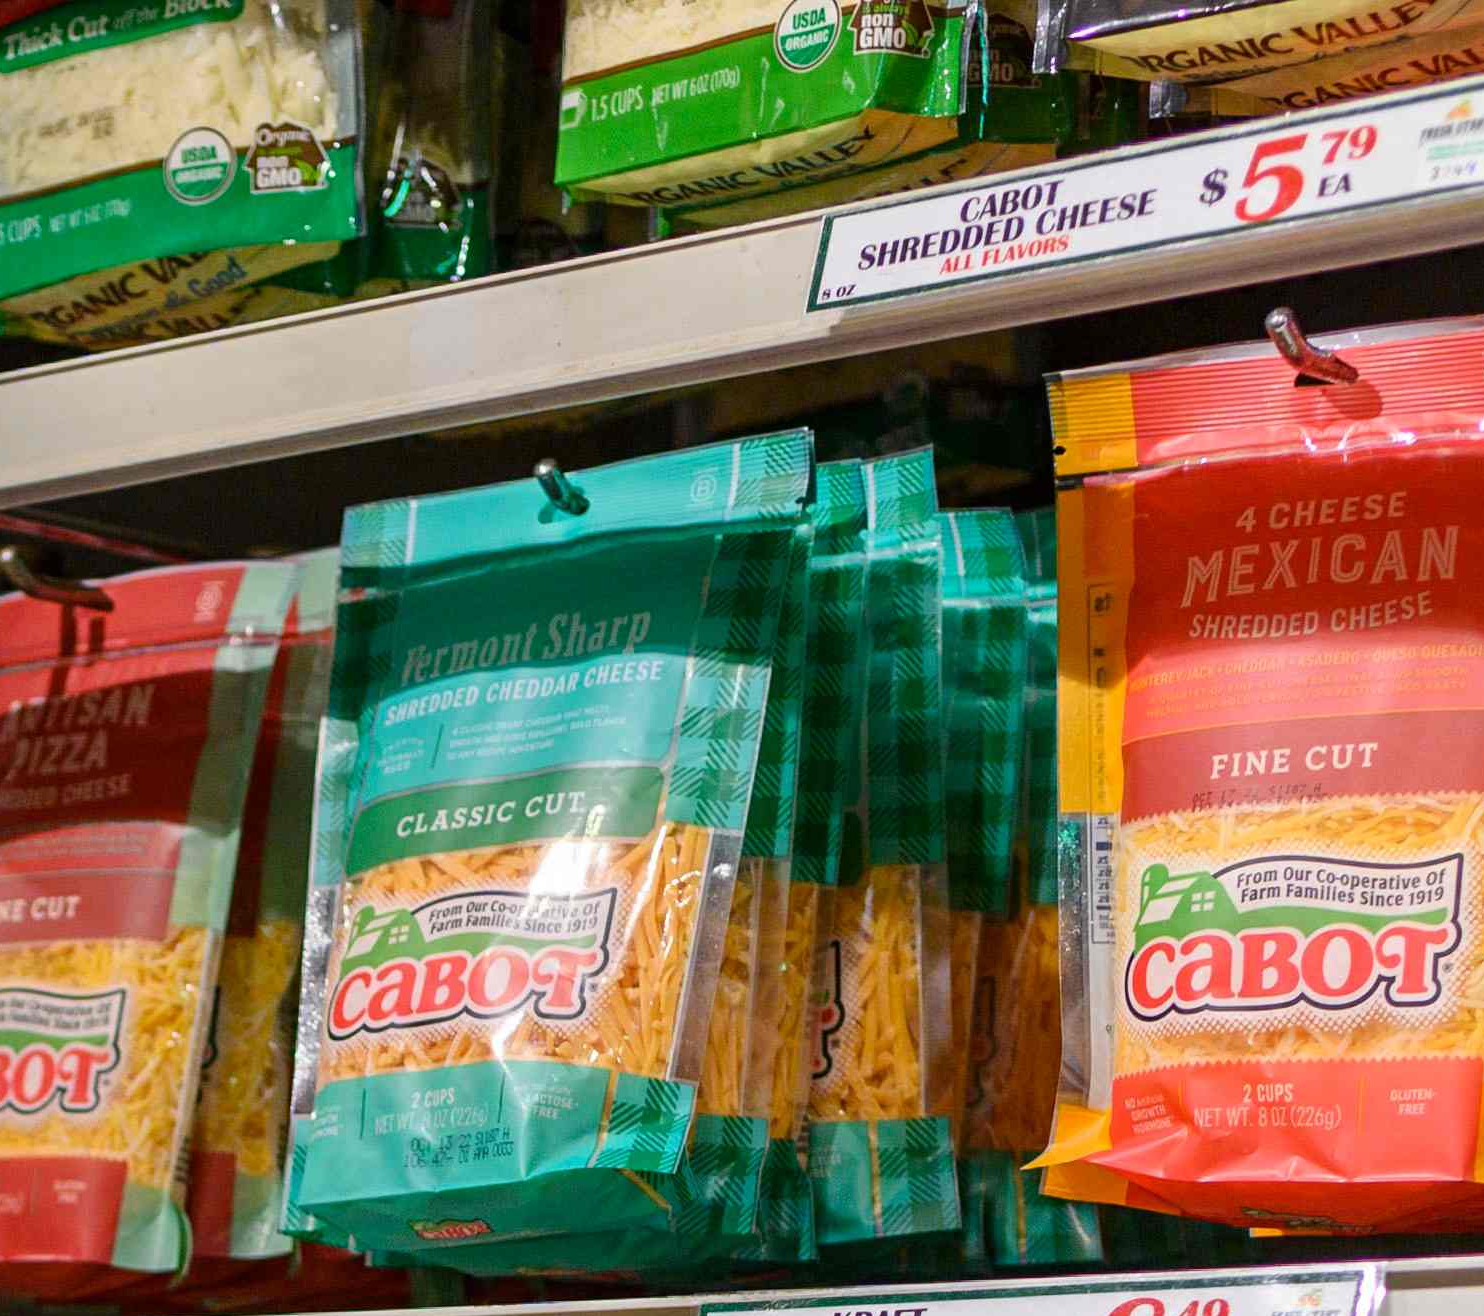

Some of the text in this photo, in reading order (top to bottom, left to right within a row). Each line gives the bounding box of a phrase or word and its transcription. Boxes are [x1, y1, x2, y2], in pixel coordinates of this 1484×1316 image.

[3, 13, 108, 61] Thick Cut
[791, 10, 828, 30] USDA
[859, 27, 908, 50] GMO
[609, 84, 644, 117] CUPS
[754, 124, 876, 178] VALLEY
[1199, 169, 1229, 207] $
[1234, 134, 1308, 224] 5
[1322, 124, 1379, 163] 79
[1317, 172, 1353, 199] EA
[960, 180, 1065, 224] CABOT
[857, 189, 1158, 272] SHREDDED CHEESE
[939, 234, 1071, 276] ALL FLAVORS
[822, 283, 857, 300] 8 OZ
[1234, 491, 1408, 534] 4 CHEESE
[1181, 525, 1460, 609] MEXICAN
[1187, 590, 1435, 641] SHREDDED CHEESE
[401, 611, 652, 686] Vermont Sharp
[385, 660, 665, 727] SHREDDED CHEDDAR CHEESE
[1210, 741, 1379, 780] FINE CUT
[396, 791, 587, 838] CLASSIC CUT
[1236, 867, 1446, 893] From Our Co-operative Of
[1240, 883, 1445, 905] Farm Families Since 1919
[29, 895, 81, 919] CUT
